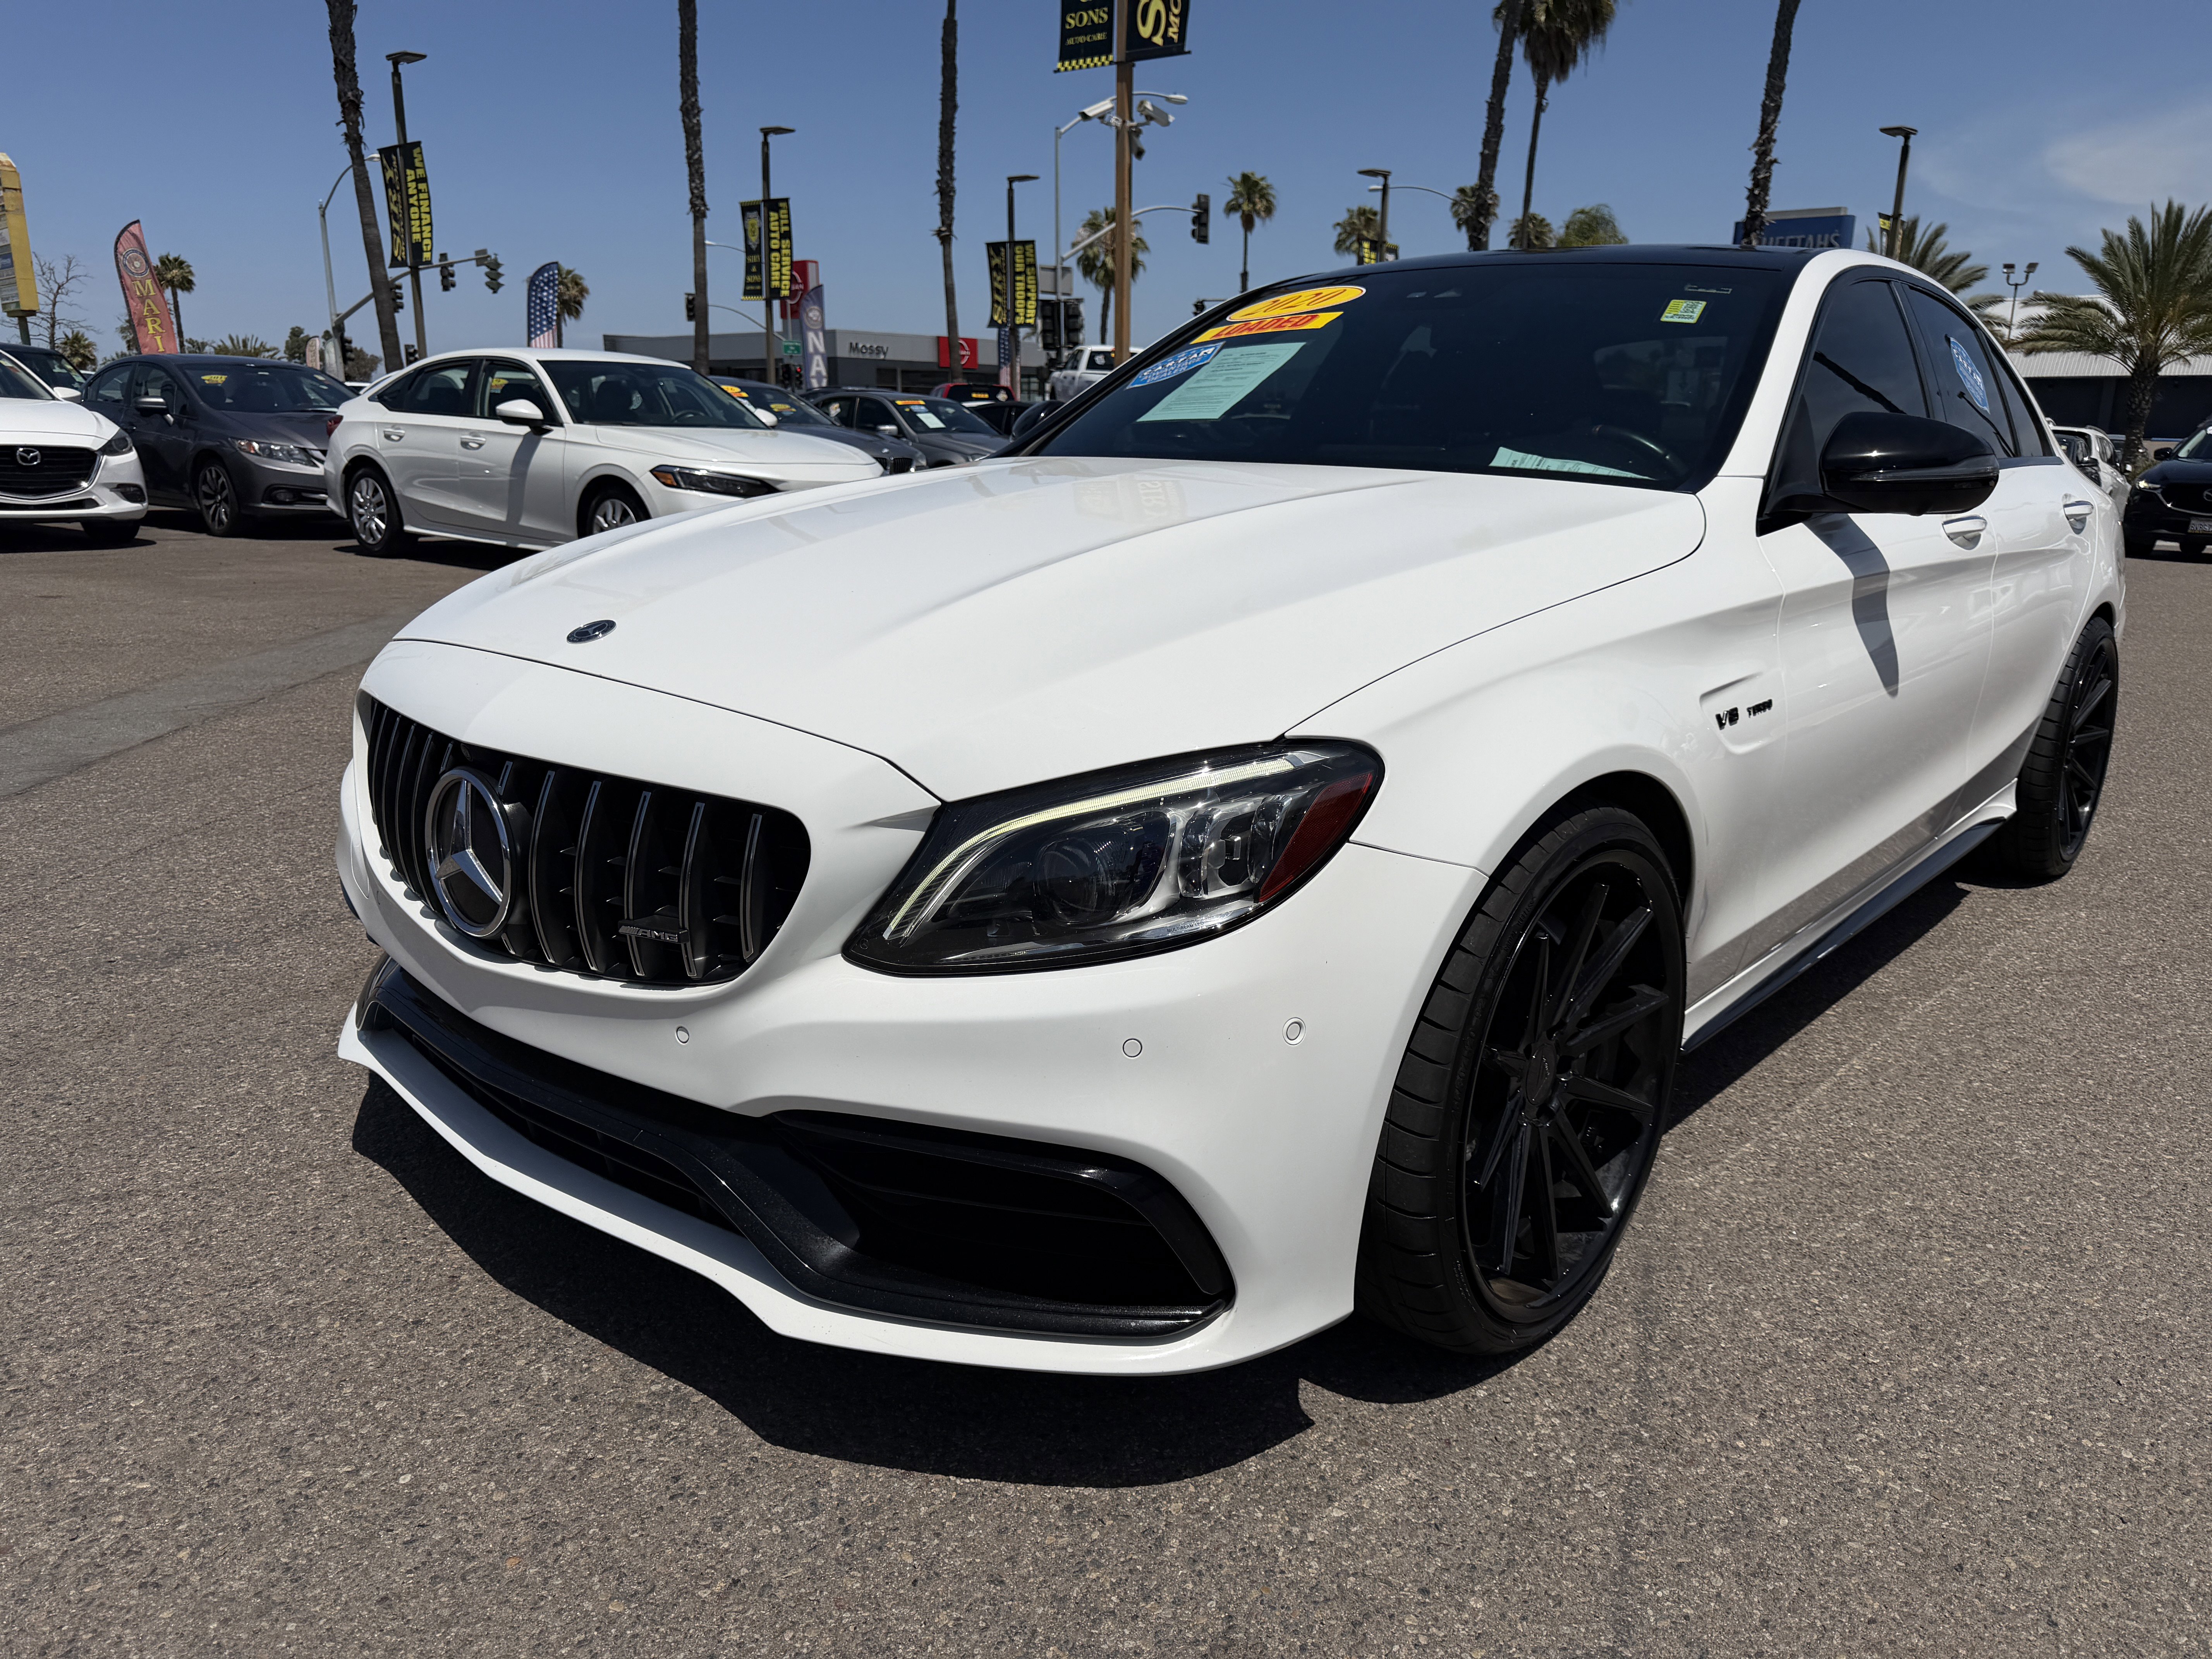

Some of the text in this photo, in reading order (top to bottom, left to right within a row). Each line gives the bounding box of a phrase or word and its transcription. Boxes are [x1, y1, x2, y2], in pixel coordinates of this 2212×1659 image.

[1065, 7, 1108, 29] SONS
[1065, 32, 1107, 45] AUTO CARE
[406, 169, 421, 243] ANYONE
[412, 147, 432, 262] WE FINANCE
[769, 211, 780, 288] AUTO CARE
[778, 202, 791, 297] FULL SERVICE
[1014, 246, 1025, 325] OUR TROOPS
[1025, 244, 1036, 325] WE SUPPORT
[1241, 289, 1347, 317] 2020
[1210, 314, 1319, 339] LOADED
[850, 342, 888, 359] Mossy
[1716, 707, 1739, 730] V8
[637, 929, 678, 943] AMG
